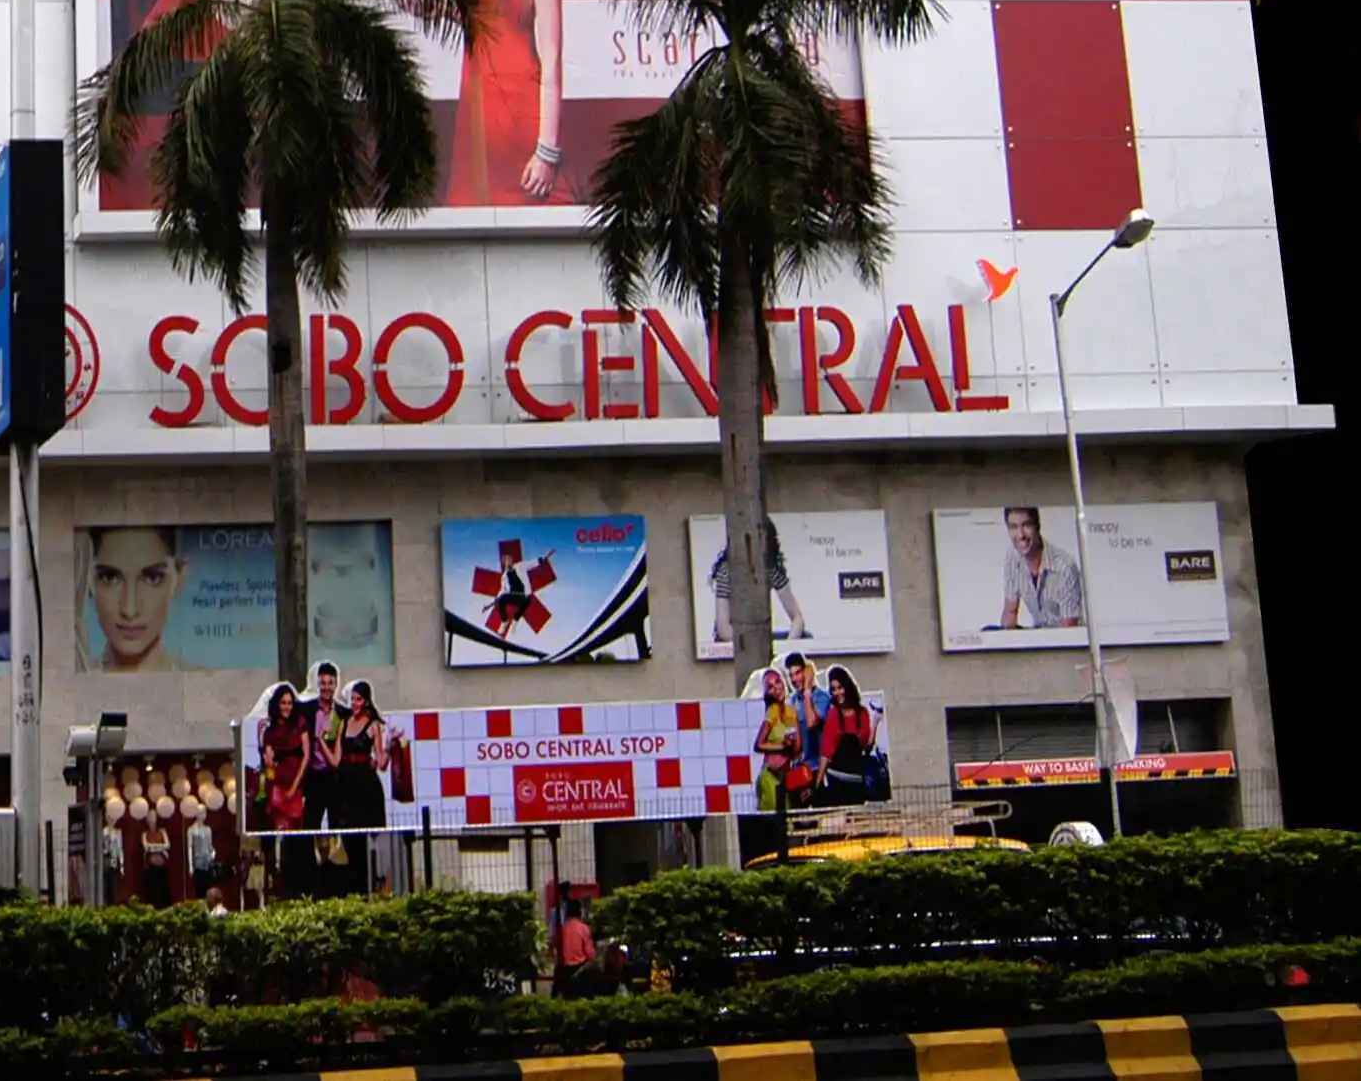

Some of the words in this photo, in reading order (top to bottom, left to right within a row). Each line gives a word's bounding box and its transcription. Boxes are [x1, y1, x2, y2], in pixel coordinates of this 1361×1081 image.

[148, 312, 464, 428] SOBO
[1169, 556, 1211, 570] BARE
[842, 577, 880, 589] BARE
[476, 741, 530, 761] SOBO
[535, 737, 616, 759] CENTRAL
[619, 735, 666, 756] STOP
[1022, 762, 1047, 775] WAY
[1048, 762, 1064, 774] TO
[541, 778, 630, 803] CENTRAL
